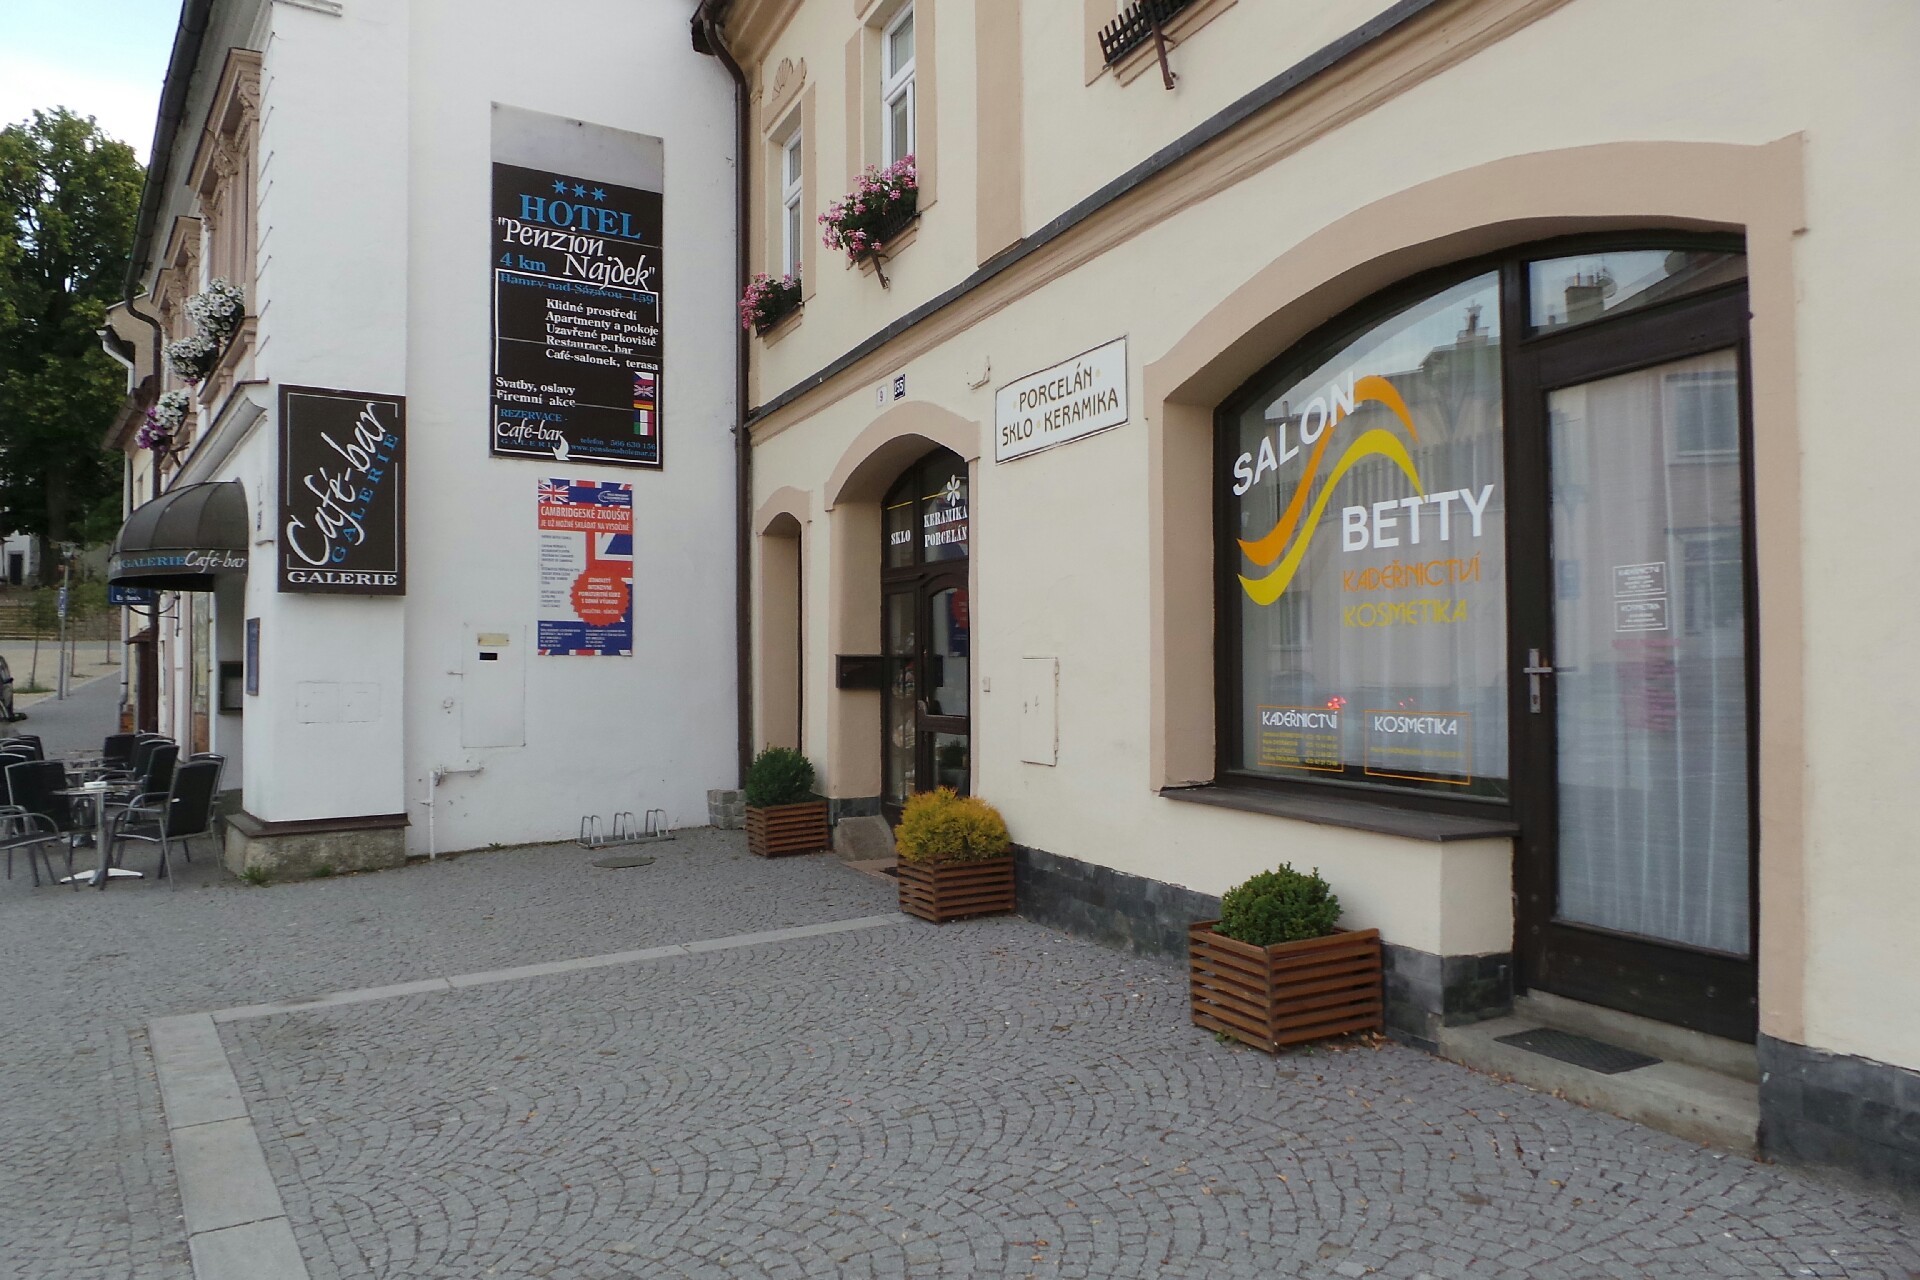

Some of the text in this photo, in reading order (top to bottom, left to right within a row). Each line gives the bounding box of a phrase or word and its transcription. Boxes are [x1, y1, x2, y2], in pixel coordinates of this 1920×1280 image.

[519, 194, 641, 239] HOTEL
[498, 216, 604, 257] "Penzion
[500, 252, 547, 273] 4 km
[562, 254, 656, 291] Najdek"
[500, 272, 544, 288] Hamry
[548, 282, 570, 293] nad
[632, 292, 654, 305] 159
[545, 298, 638, 321] Klidné prostředí
[545, 311, 659, 337] Apartmenty a pokoje
[545, 323, 657, 347] Uzavřené parkoviště
[545, 348, 659, 371] Café-salonek, terasa
[614, 344, 634, 355] bar
[495, 376, 576, 397] Svatby, oslavy
[496, 389, 576, 408] Firemní akce
[1019, 361, 1092, 413] PORCELÁN
[500, 409, 562, 422] REZERVACE
[1002, 387, 1119, 447] SKLO KERAMIKA
[497, 417, 564, 443] Café-bar
[1232, 371, 1355, 496] SALON
[286, 402, 386, 567] Café-bar
[331, 434, 399, 564] GALERIE
[541, 506, 630, 521] CAMBRIDGESKÉ ZKOUŠKY
[923, 505, 968, 529] KERAMIKA
[1343, 484, 1494, 552] BETTY
[890, 529, 911, 546] SKLO
[924, 525, 968, 548] PORCELÁN
[121, 550, 247, 574] GALERIE Café-bar
[1343, 551, 1481, 593] KADEŘNICTVÍ
[287, 571, 398, 586] GALERIE
[1344, 598, 1468, 628] KOSMETIKA
[1262, 709, 1338, 730] KADEŘNICTVÍ
[1374, 715, 1458, 736] KOSMETIKA
